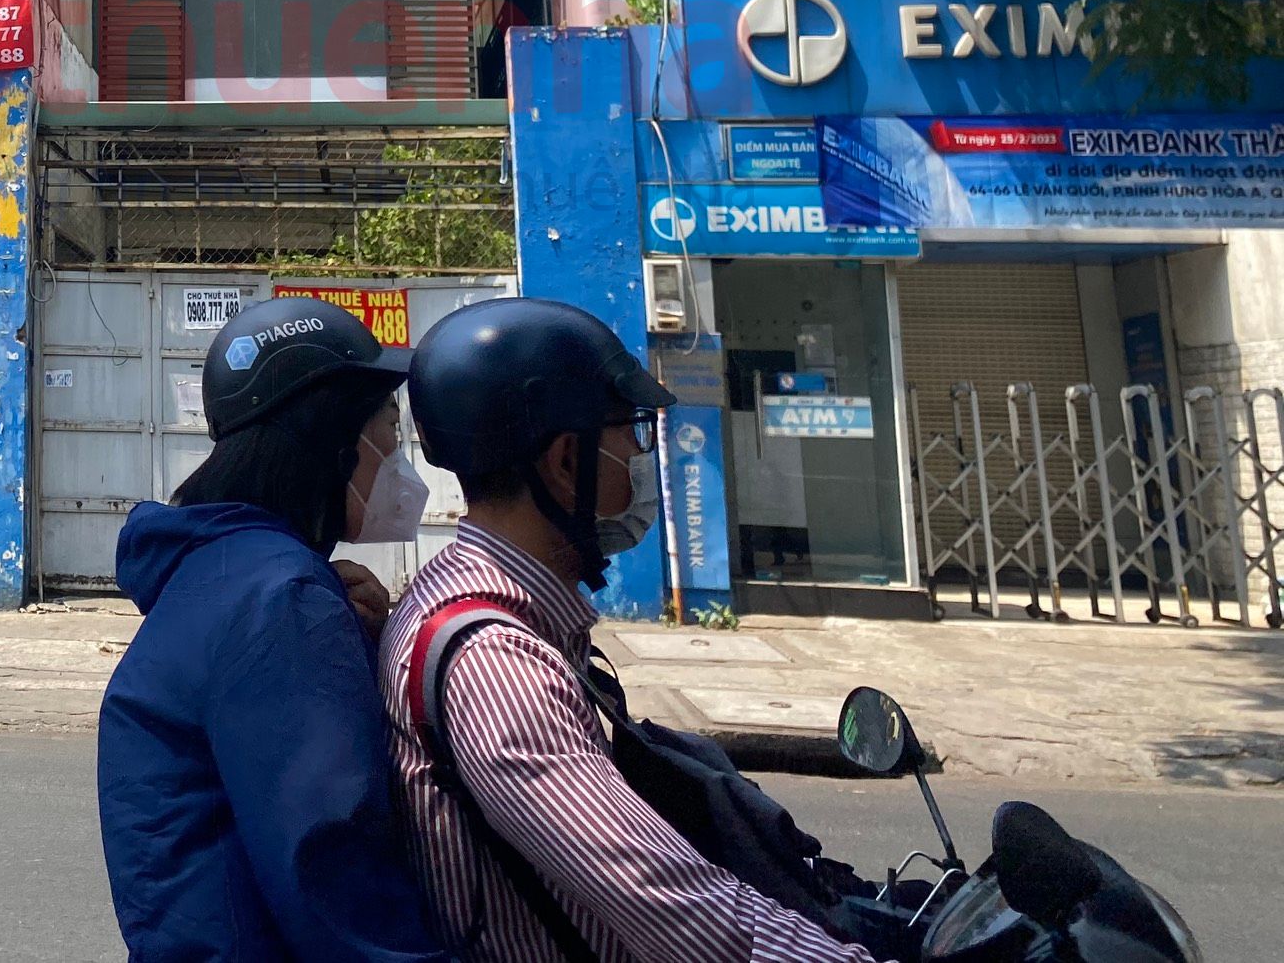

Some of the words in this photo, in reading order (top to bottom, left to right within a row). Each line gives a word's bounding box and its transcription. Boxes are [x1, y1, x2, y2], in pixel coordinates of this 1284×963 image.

[765, 142, 790, 153] MUA
[792, 140, 815, 153] BÁN
[968, 133, 996, 147] ngày
[1070, 128, 1229, 157] EXIMBANK
[1190, 163, 1237, 182] hoạt
[707, 205, 917, 234] EXIMB
[187, 292, 202, 300] CHO
[204, 290, 222, 300] THUÊ
[368, 289, 406, 307] NHÀ
[187, 301, 239, 322] 0908.777.488
[255, 317, 325, 348] PIAGGIO
[781, 407, 838, 425] ATM
[684, 464, 705, 569] EXIMBANK
